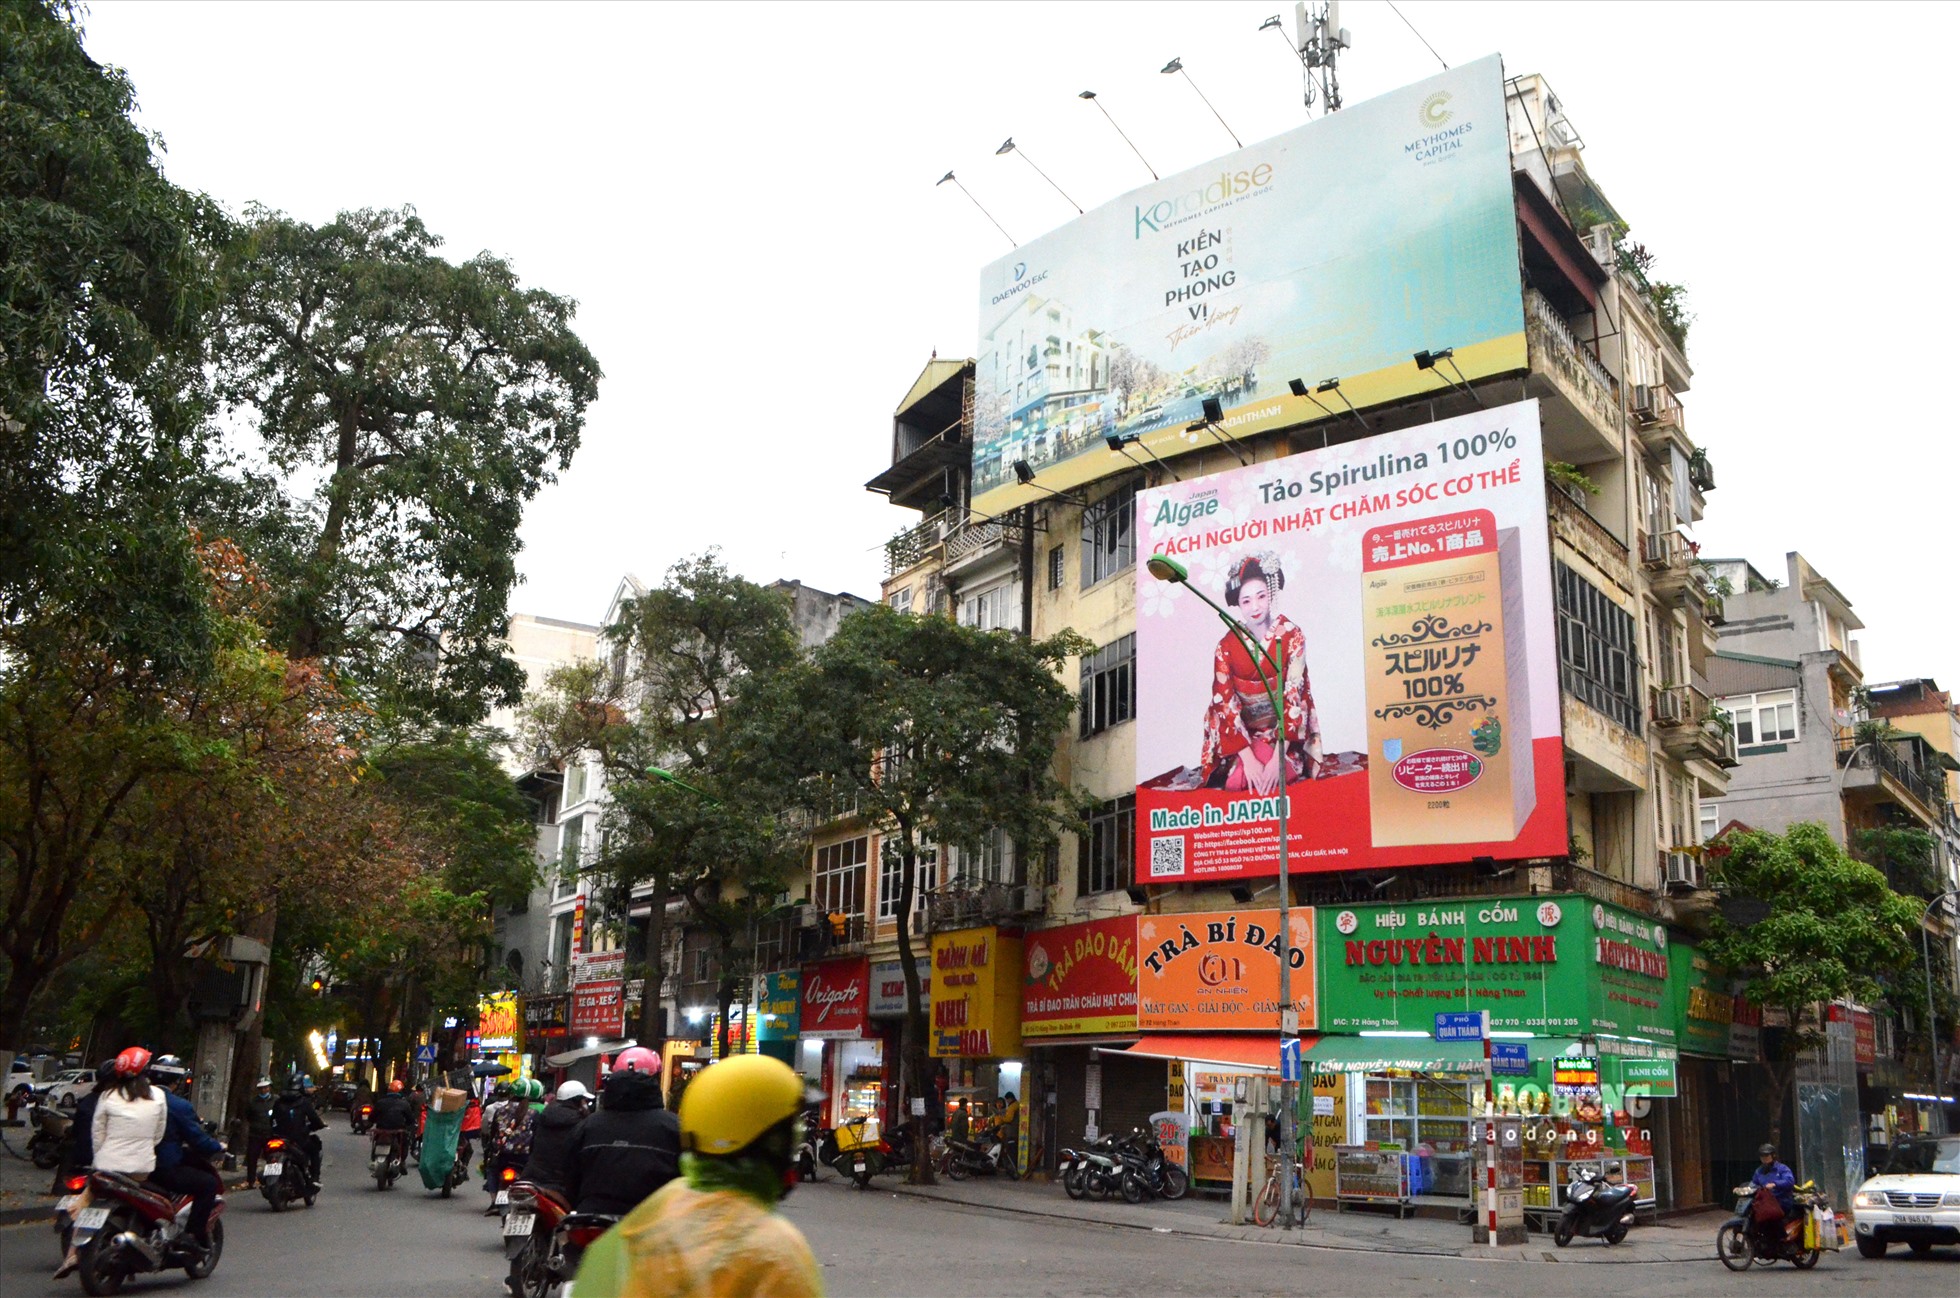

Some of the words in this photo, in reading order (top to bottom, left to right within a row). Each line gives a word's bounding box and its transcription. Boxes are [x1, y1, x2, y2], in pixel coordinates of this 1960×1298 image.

[1404, 122, 1473, 153] MEYHOMES
[1415, 138, 1463, 161] CAPITAL
[1135, 163, 1273, 240] Koradise
[1163, 211, 1203, 230] MEYHOMES
[1204, 200, 1234, 216] CAPITAL
[1177, 229, 1222, 258] KIẾN
[1180, 253, 1219, 280] TẠO
[992, 279, 1031, 306] DAEWOO
[1031, 269, 1049, 285] E&C
[1165, 270, 1236, 307] PHONG
[1188, 303, 1208, 322] VỊ
[1259, 478, 1303, 505] Tảo
[1309, 453, 1429, 496] Spirulina
[1436, 427, 1517, 464] 100%
[1153, 534, 1201, 558] CÁCH
[1205, 519, 1268, 549] NGƯỜI
[1272, 507, 1325, 534] NHẬT
[1328, 494, 1391, 521] CHĂM
[1395, 481, 1439, 508] SÓC
[1442, 472, 1474, 497] CƠ
[1476, 457, 1521, 490] THỂ
[1188, 489, 1218, 500] Japan
[1153, 498, 1219, 528] Algae
[1371, 529, 1484, 564] 売上No.1商品
[1385, 642, 1481, 676] スピルリナ
[1402, 672, 1465, 699] 100%
[1151, 807, 1201, 831] Made
[1204, 804, 1223, 826] in
[1193, 832, 1220, 840] Website:
[1204, 833, 1303, 849] https://facebook.com/sp0.vn
[1193, 866, 1217, 874] HOTLINE:
[1375, 910, 1406, 930] HIỆU
[1417, 907, 1465, 926] BÁNH
[1478, 900, 1518, 923] CỐM
[936, 940, 970, 970] BÁNH
[1144, 924, 1200, 974] TRÀ
[1206, 916, 1236, 943] BÍ
[1243, 924, 1305, 969] ĐAO
[1344, 931, 1466, 967] NGUYÊN
[1472, 935, 1557, 965] NINH
[1048, 945, 1074, 991] TRÀ
[1075, 928, 1105, 962] ĐÀO
[586, 996, 596, 1007] GA
[805, 975, 860, 1023] Origato
[1027, 998, 1038, 1013] TRÀ
[1039, 997, 1046, 1012] BÍ
[1047, 999, 1062, 1012] ĐAO
[1081, 992, 1102, 1009] CHÂU
[1102, 993, 1117, 1010] HẠT
[1118, 992, 1138, 1006] CHIA
[1216, 986, 1249, 995] NHIÊN
[935, 991, 969, 1028] NHƯ
[1144, 1000, 1166, 1014] MÁT
[1167, 1002, 1189, 1013] GAN
[1197, 999, 1219, 1014] GIẢI
[1221, 999, 1244, 1018] ĐỘC
[1290, 999, 1306, 1013] ÂN
[1381, 1018, 1399, 1026] Than
[1453, 1015, 1470, 1023] PHỐ
[960, 1028, 991, 1056] HOA
[1457, 1024, 1480, 1037] THÁNH
[1505, 1046, 1519, 1054] PHỐ
[1208, 1074, 1224, 1083] TRÀ
[1318, 1057, 1345, 1073] CỐM
[1344, 1058, 1392, 1073] NGUYÊN
[1424, 1057, 1444, 1071] SỐ
[1445, 1061, 1453, 1071] 1
[1628, 1066, 1651, 1076] BÁNH
[1651, 1065, 1669, 1076] CỐM
